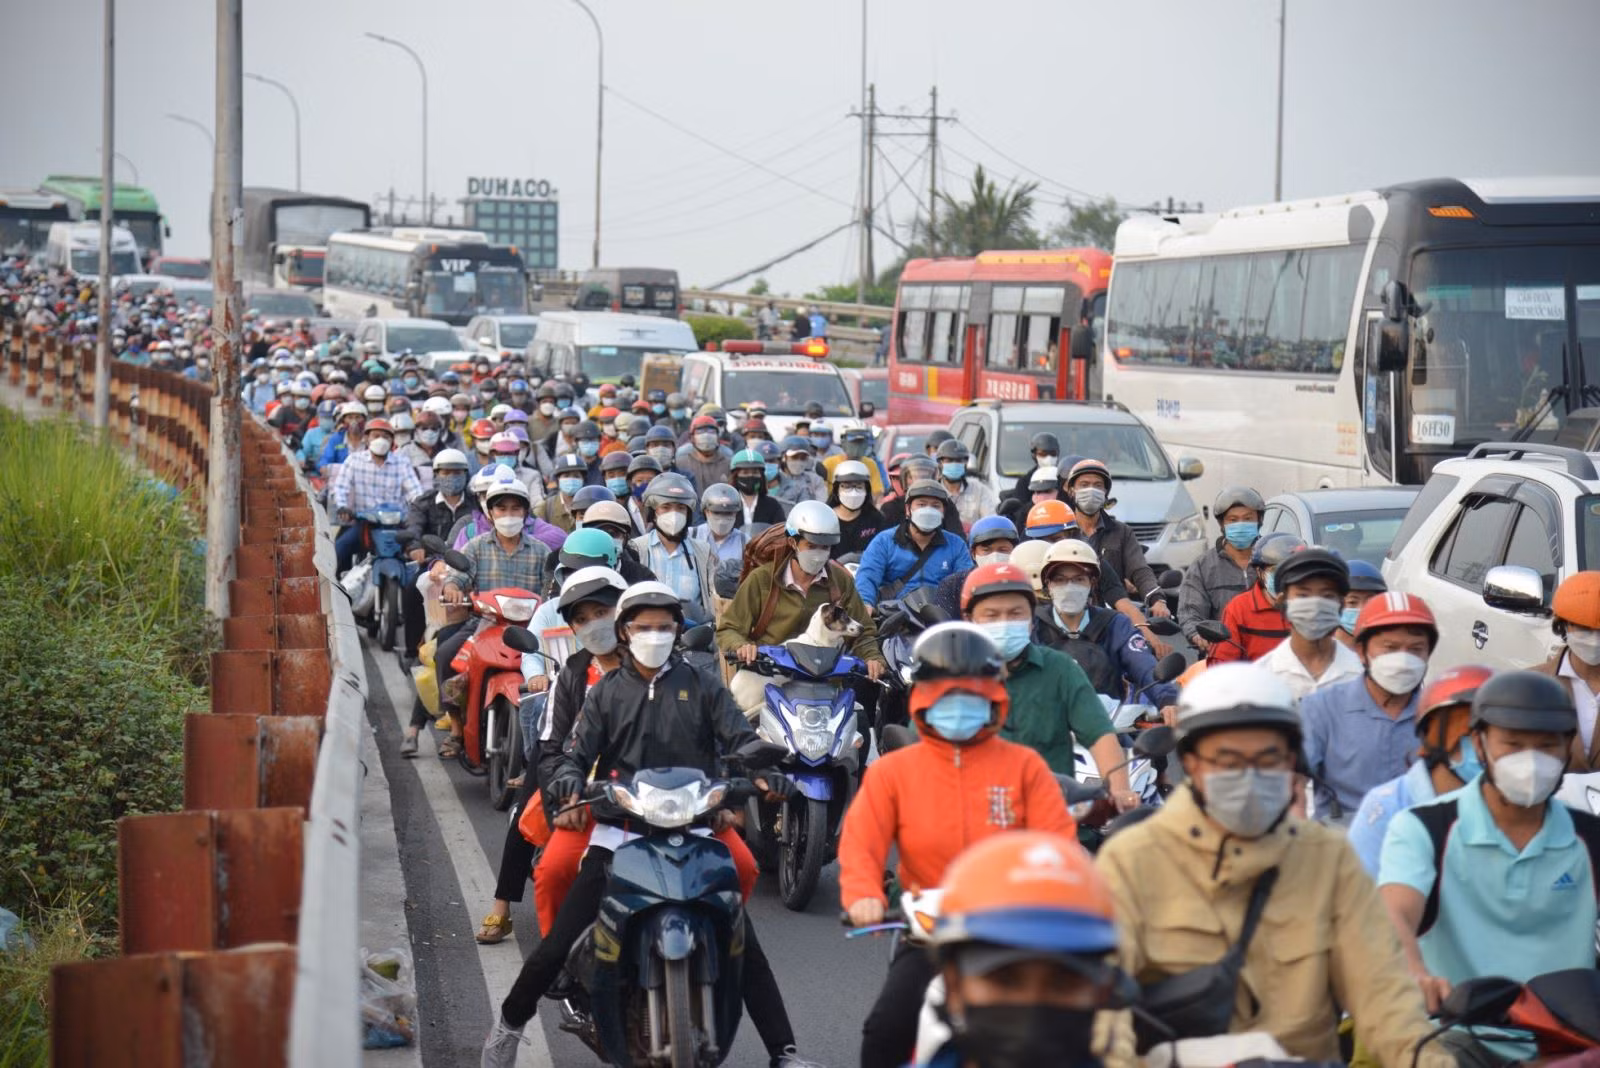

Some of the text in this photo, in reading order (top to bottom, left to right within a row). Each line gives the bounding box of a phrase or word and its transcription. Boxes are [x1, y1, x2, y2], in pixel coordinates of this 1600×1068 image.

[468, 177, 550, 197] DUHACO
[441, 259, 471, 272] VIP
[1417, 420, 1450, 437] 16H30
